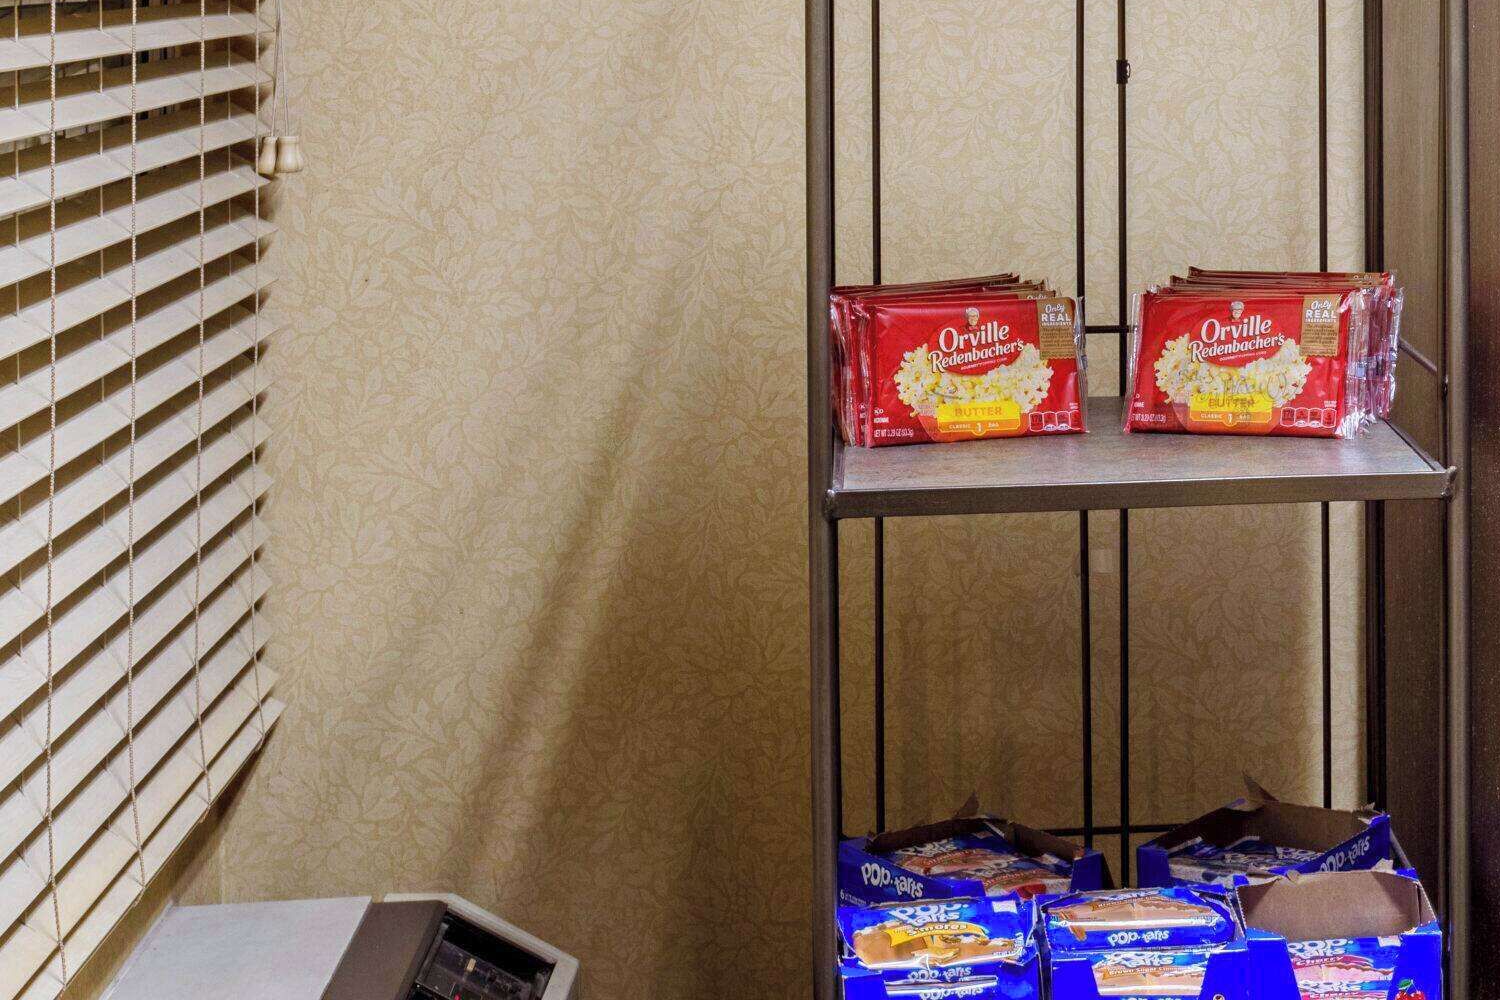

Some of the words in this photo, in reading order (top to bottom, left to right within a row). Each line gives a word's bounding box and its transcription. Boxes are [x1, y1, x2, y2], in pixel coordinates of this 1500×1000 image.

[1045, 304, 1065, 314] Only
[1310, 300, 1333, 310] Only
[1041, 313, 1072, 323] REAL
[1305, 310, 1337, 319] REAL
[1201, 314, 1272, 343] Orville
[939, 321, 1010, 352] Orville
[1189, 332, 1285, 363] Redenbacher's
[928, 338, 1025, 374] Redenbacher's
[1208, 397, 1254, 408] BUTTER
[954, 405, 1003, 417] BUTTER
